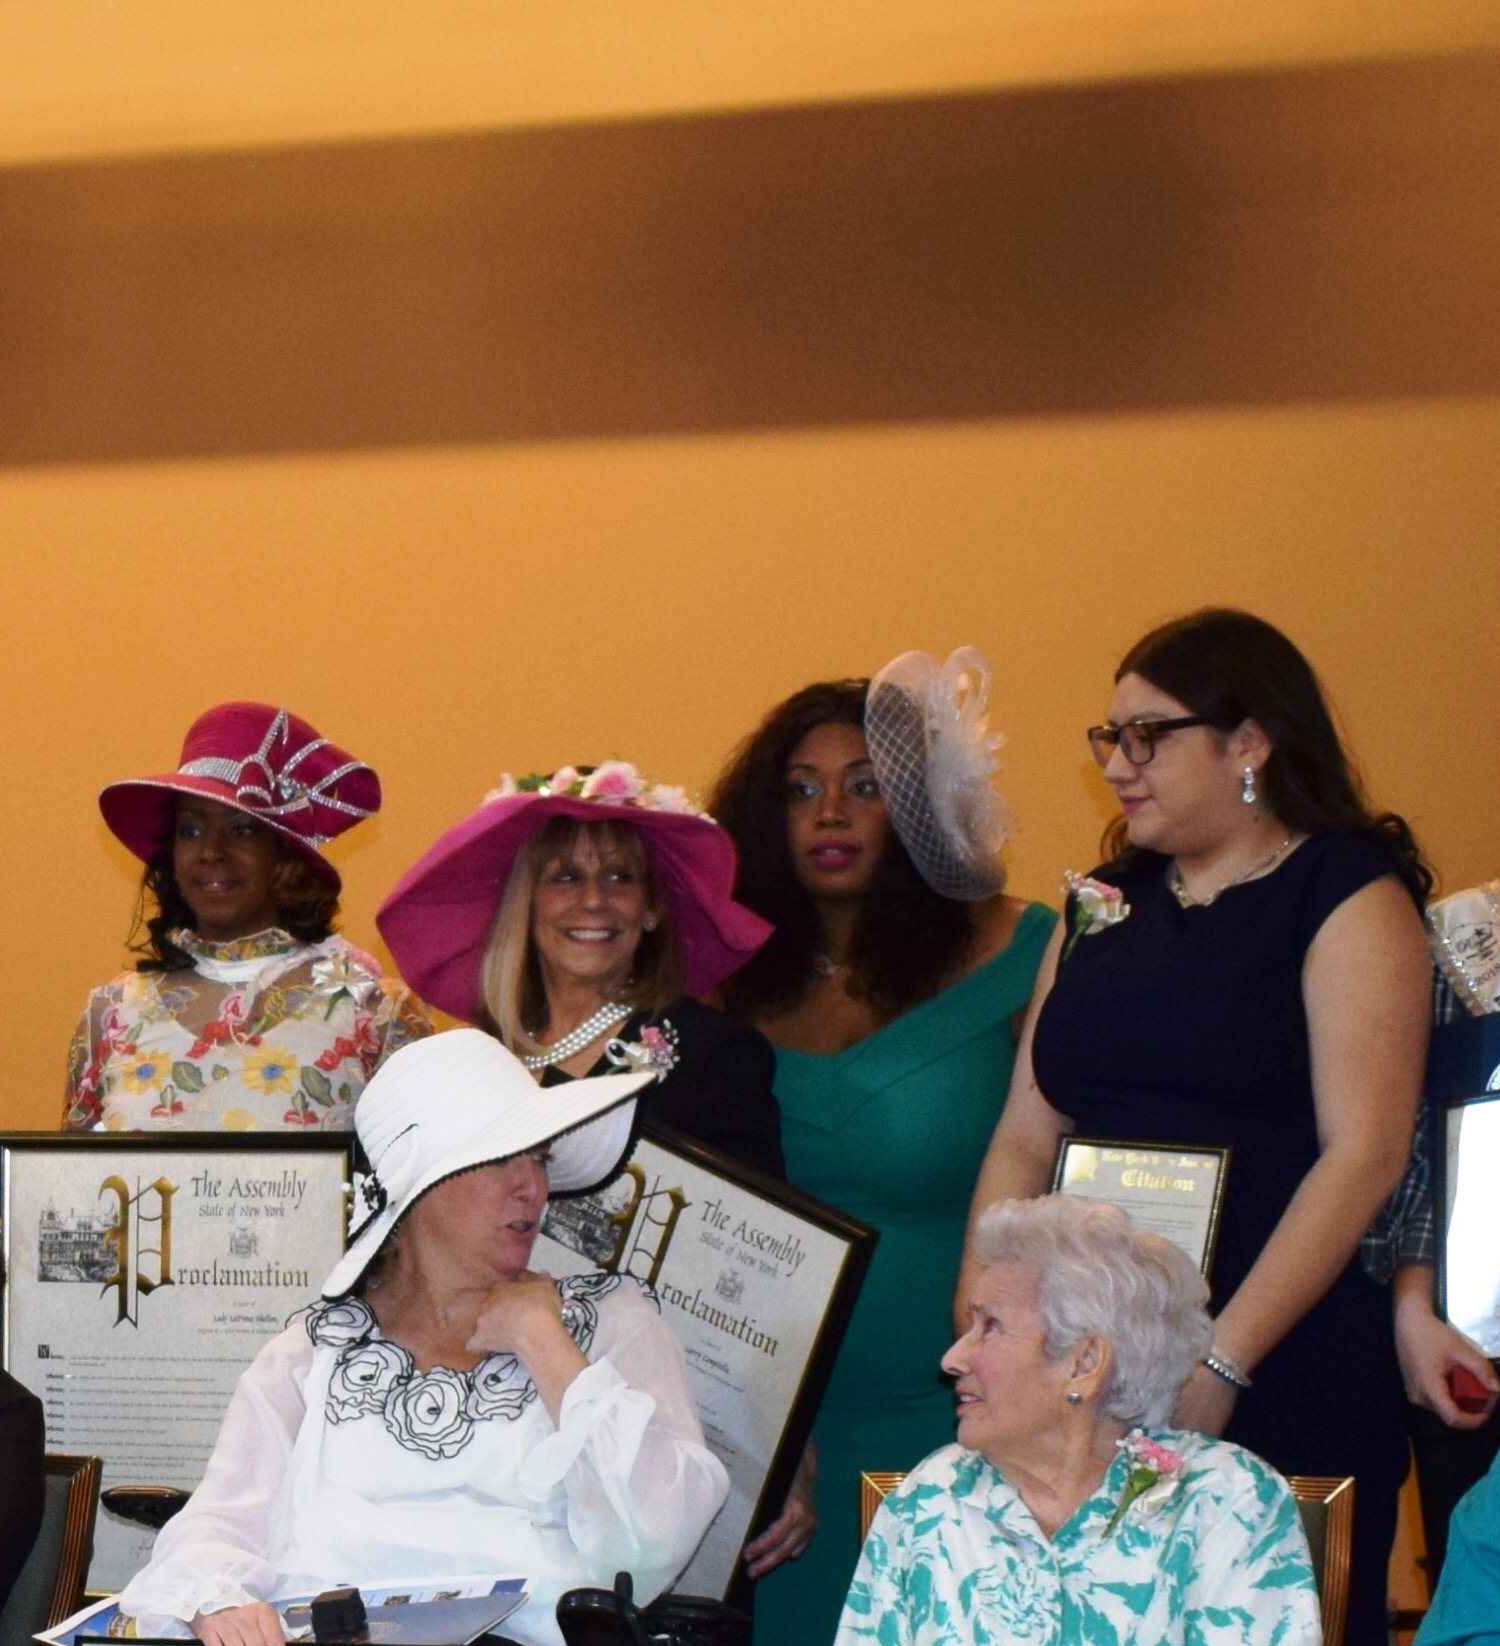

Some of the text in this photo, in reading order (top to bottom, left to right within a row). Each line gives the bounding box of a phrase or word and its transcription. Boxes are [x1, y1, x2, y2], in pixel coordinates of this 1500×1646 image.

[191, 1170, 307, 1210] The Assembly
[199, 1203, 286, 1220] State of New York
[98, 1174, 309, 1329] Proclamation
[700, 1199, 807, 1278] The Assembly
